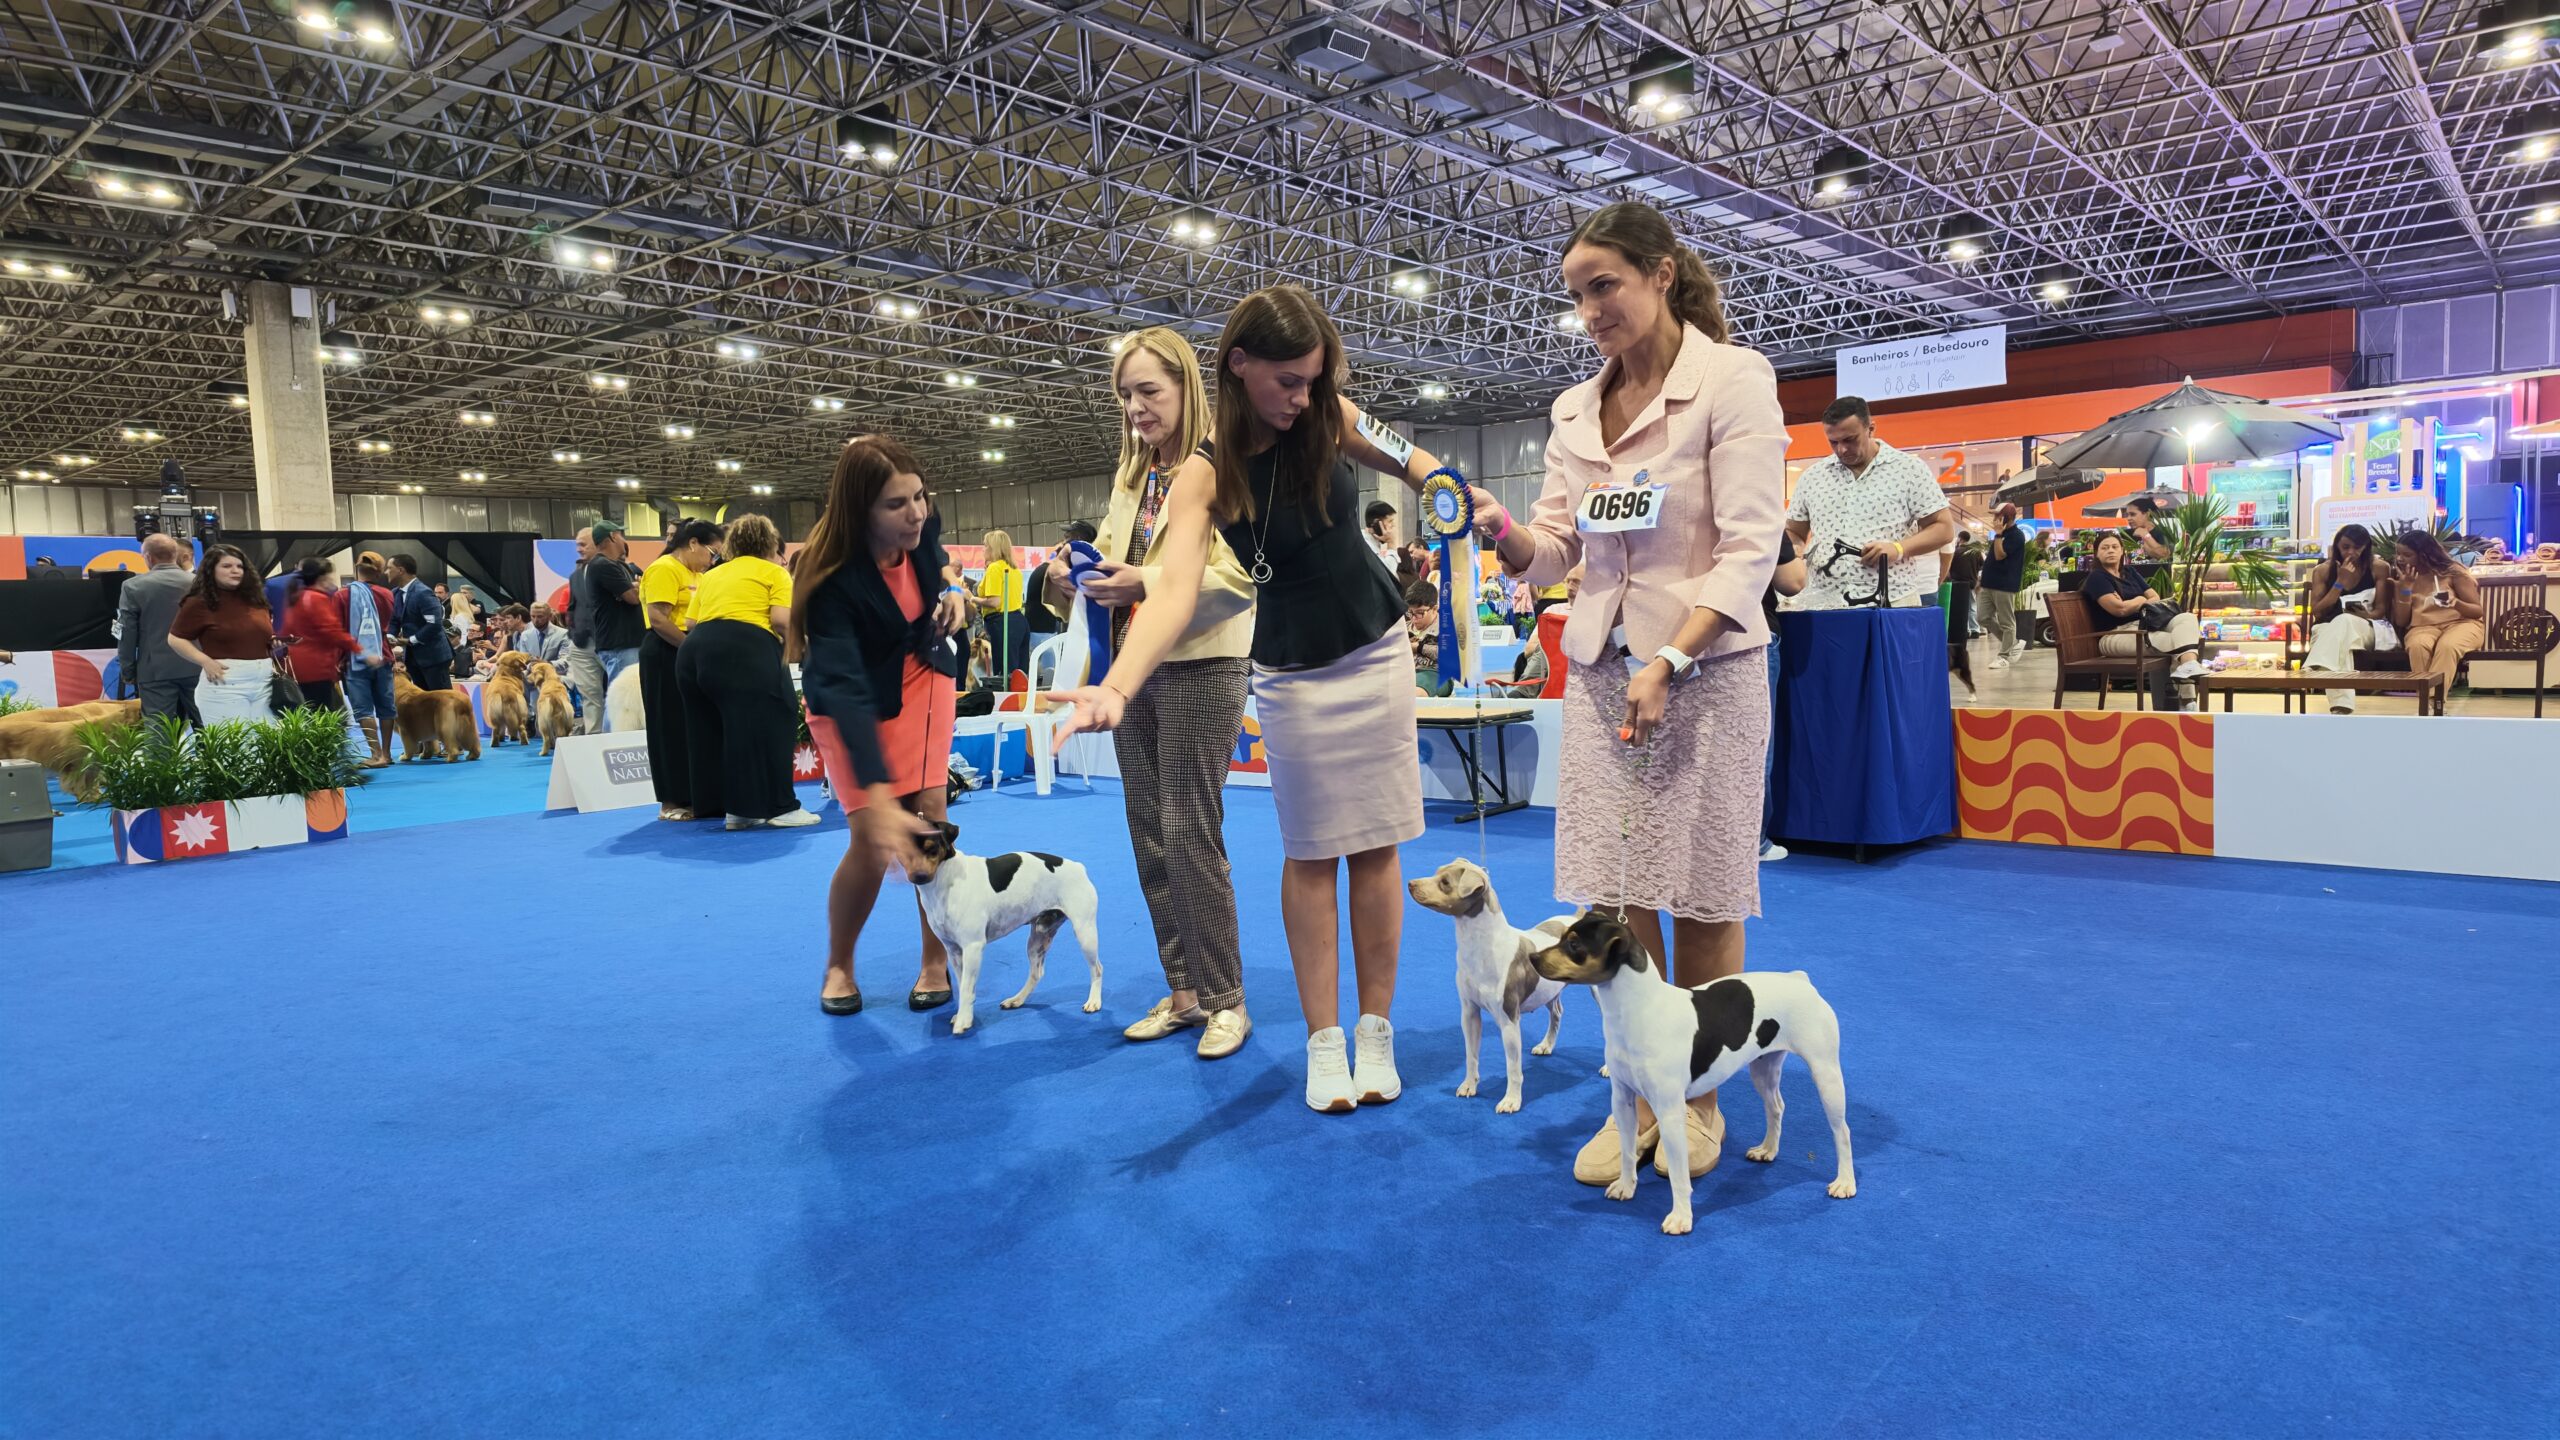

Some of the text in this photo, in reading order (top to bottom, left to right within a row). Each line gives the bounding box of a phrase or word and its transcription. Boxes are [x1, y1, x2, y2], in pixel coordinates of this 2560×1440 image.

[1852, 338, 1989, 365] Banheiros / Bebedouro
[1937, 450, 1965, 484] 2
[1588, 490, 1653, 521] 0696
